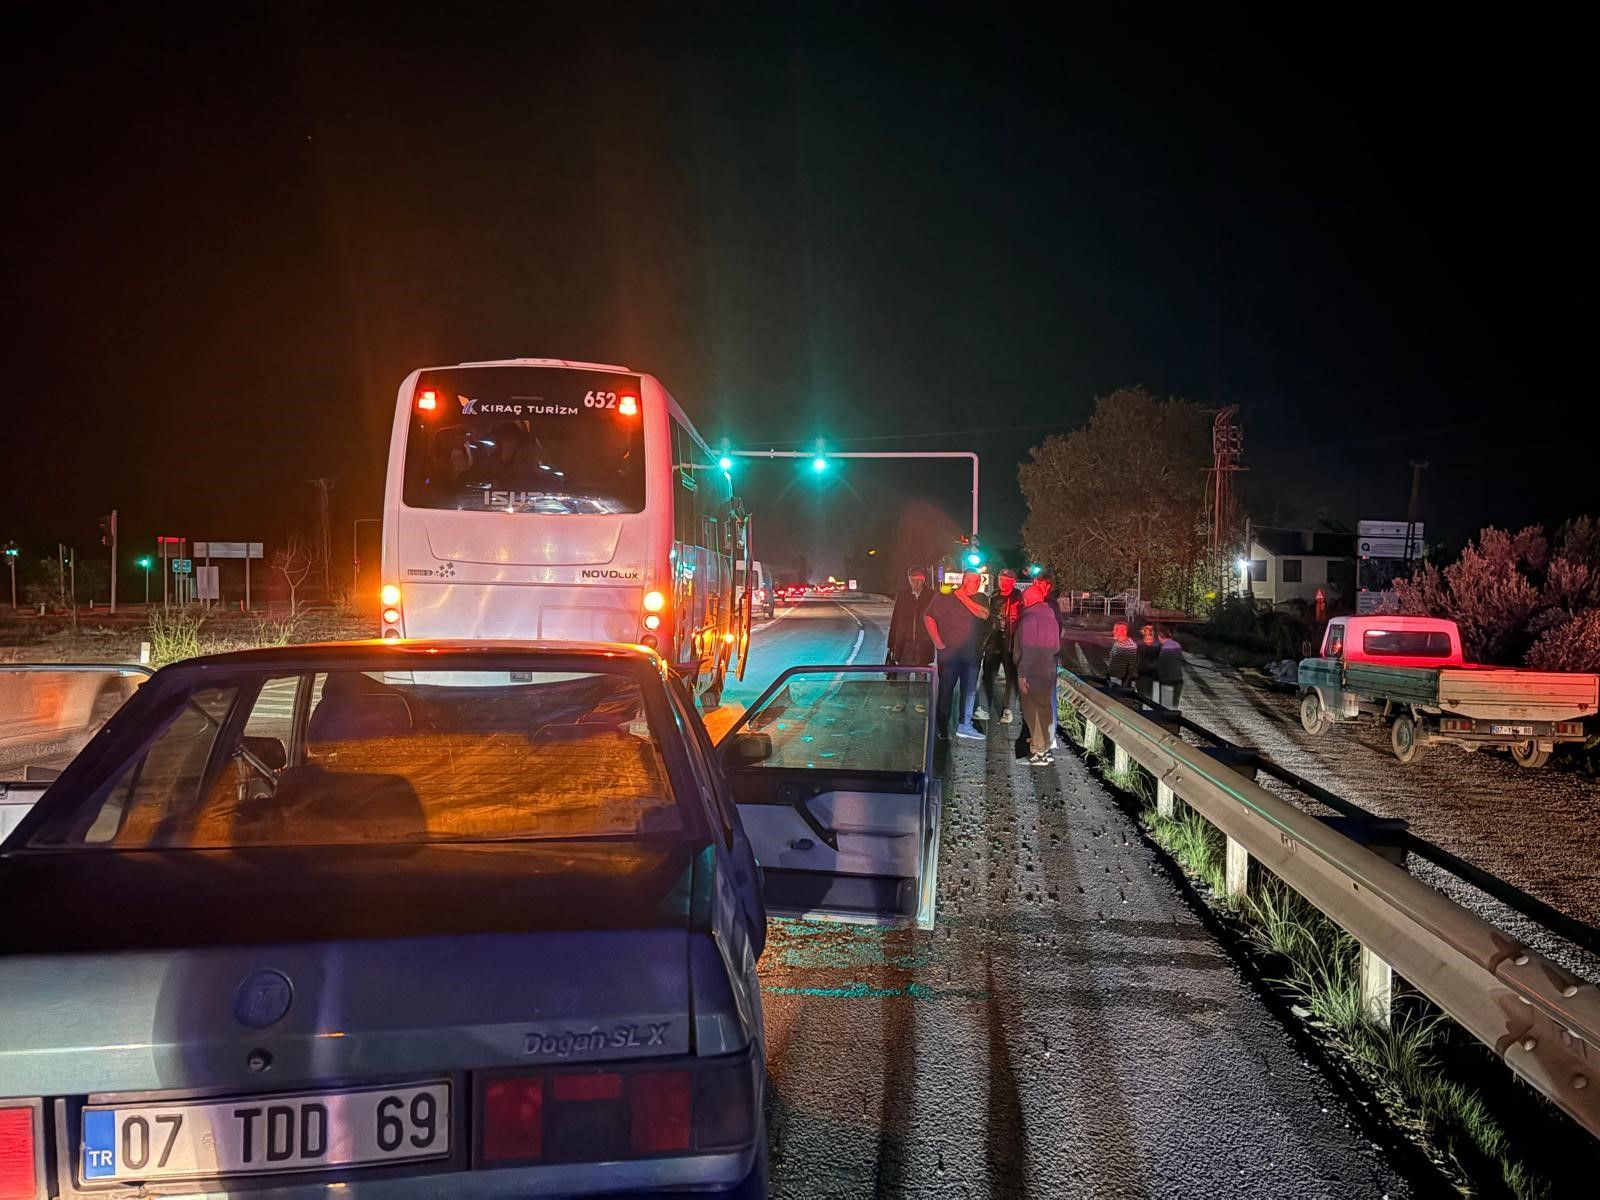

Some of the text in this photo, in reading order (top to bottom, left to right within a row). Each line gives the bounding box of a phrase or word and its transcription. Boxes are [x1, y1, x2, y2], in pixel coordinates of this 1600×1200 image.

[584, 391, 617, 409] 652
[481, 404, 579, 415] KIRAÇ TURİZM
[88, 1092, 437, 1170] TR 07 TDD 69
